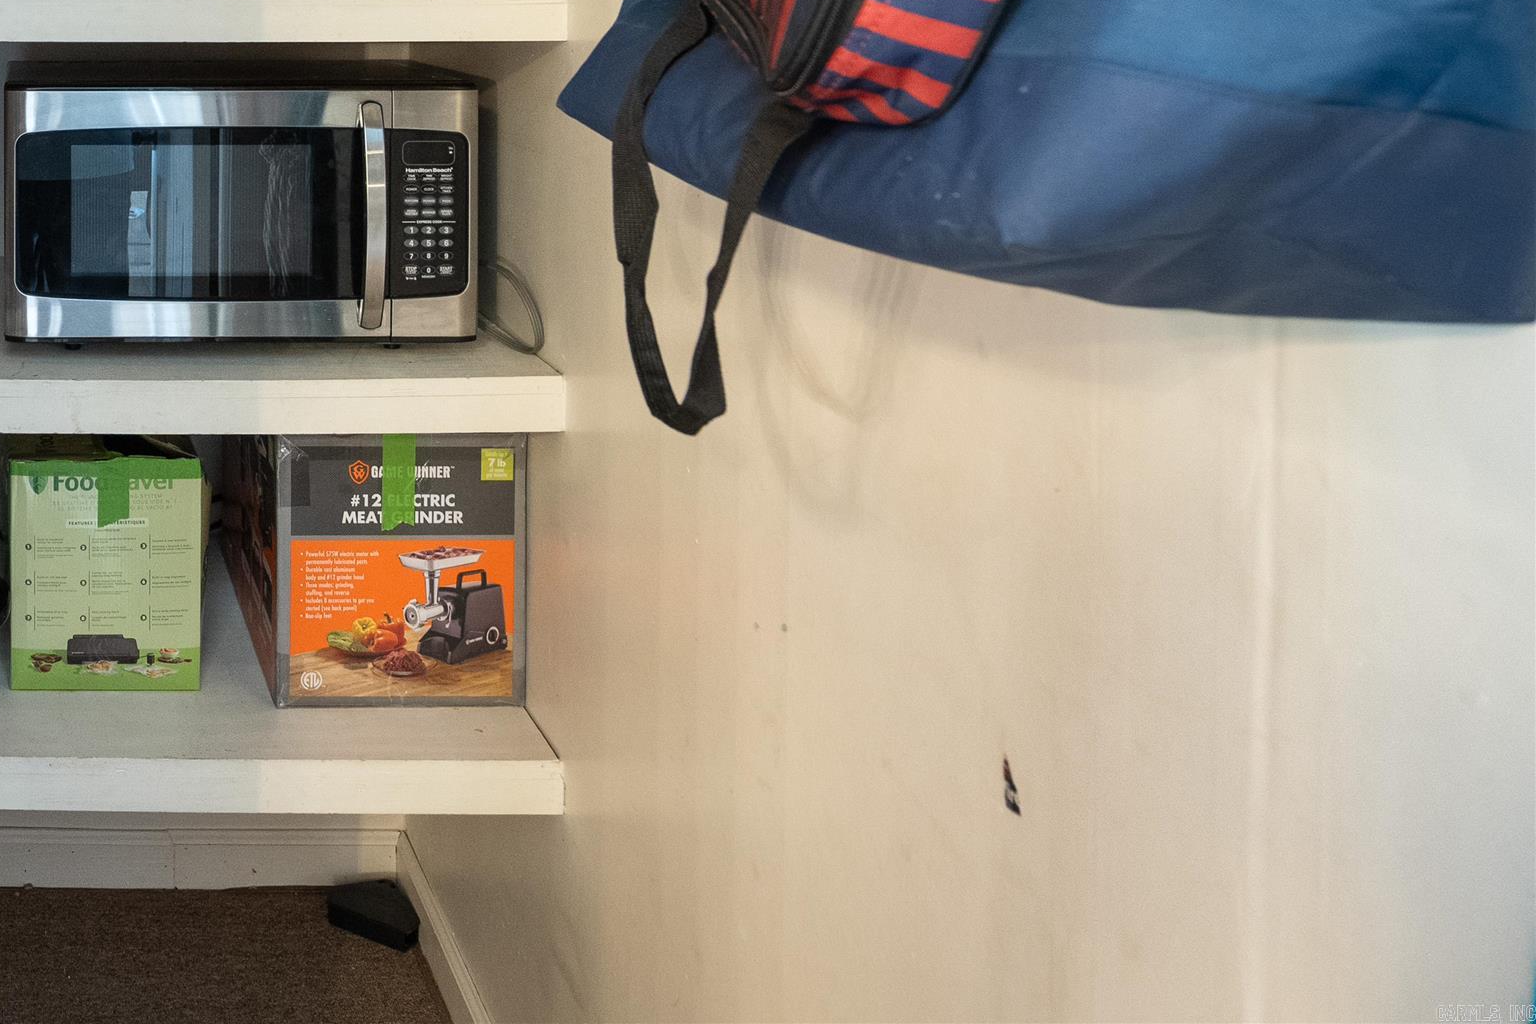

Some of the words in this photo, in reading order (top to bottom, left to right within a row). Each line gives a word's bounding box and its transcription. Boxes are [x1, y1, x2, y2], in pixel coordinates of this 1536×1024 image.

[350, 494, 382, 507] #12
[386, 493, 456, 507] ELECTRIC
[341, 510, 384, 524] MEAT
[391, 510, 464, 524] GRINDER
